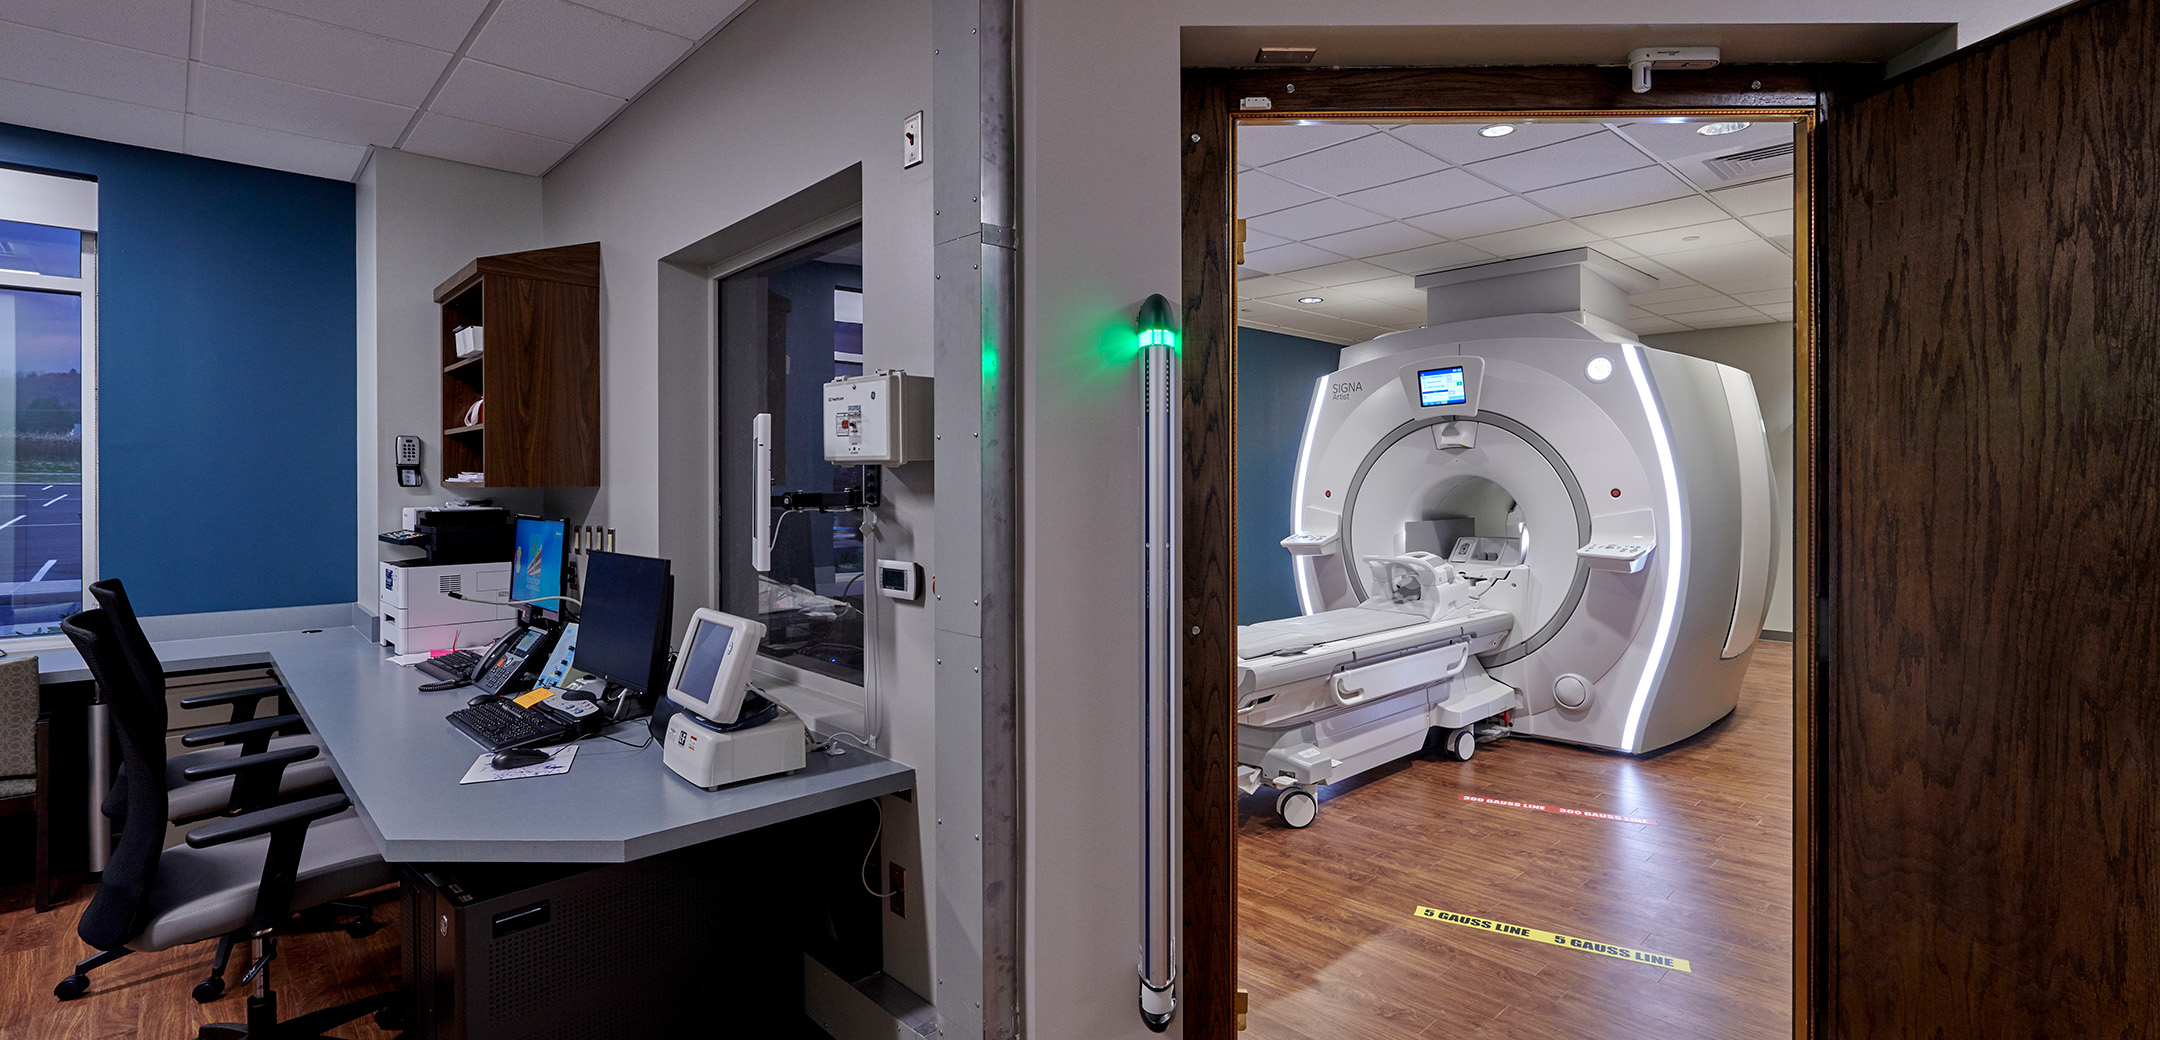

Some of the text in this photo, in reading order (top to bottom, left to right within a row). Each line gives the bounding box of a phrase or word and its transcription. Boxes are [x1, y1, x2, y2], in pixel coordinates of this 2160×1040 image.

[1332, 382, 1363, 393] SIGNA
[1332, 393, 1350, 401] Artist
[1463, 795, 1485, 803] 300
[1486, 798, 1521, 807] GAUSS
[1559, 807, 1582, 815] 300
[1584, 811, 1622, 820] GAUSS
[1423, 908, 1675, 968] 5 GAUSS LINE 5 GAUSS LINE
